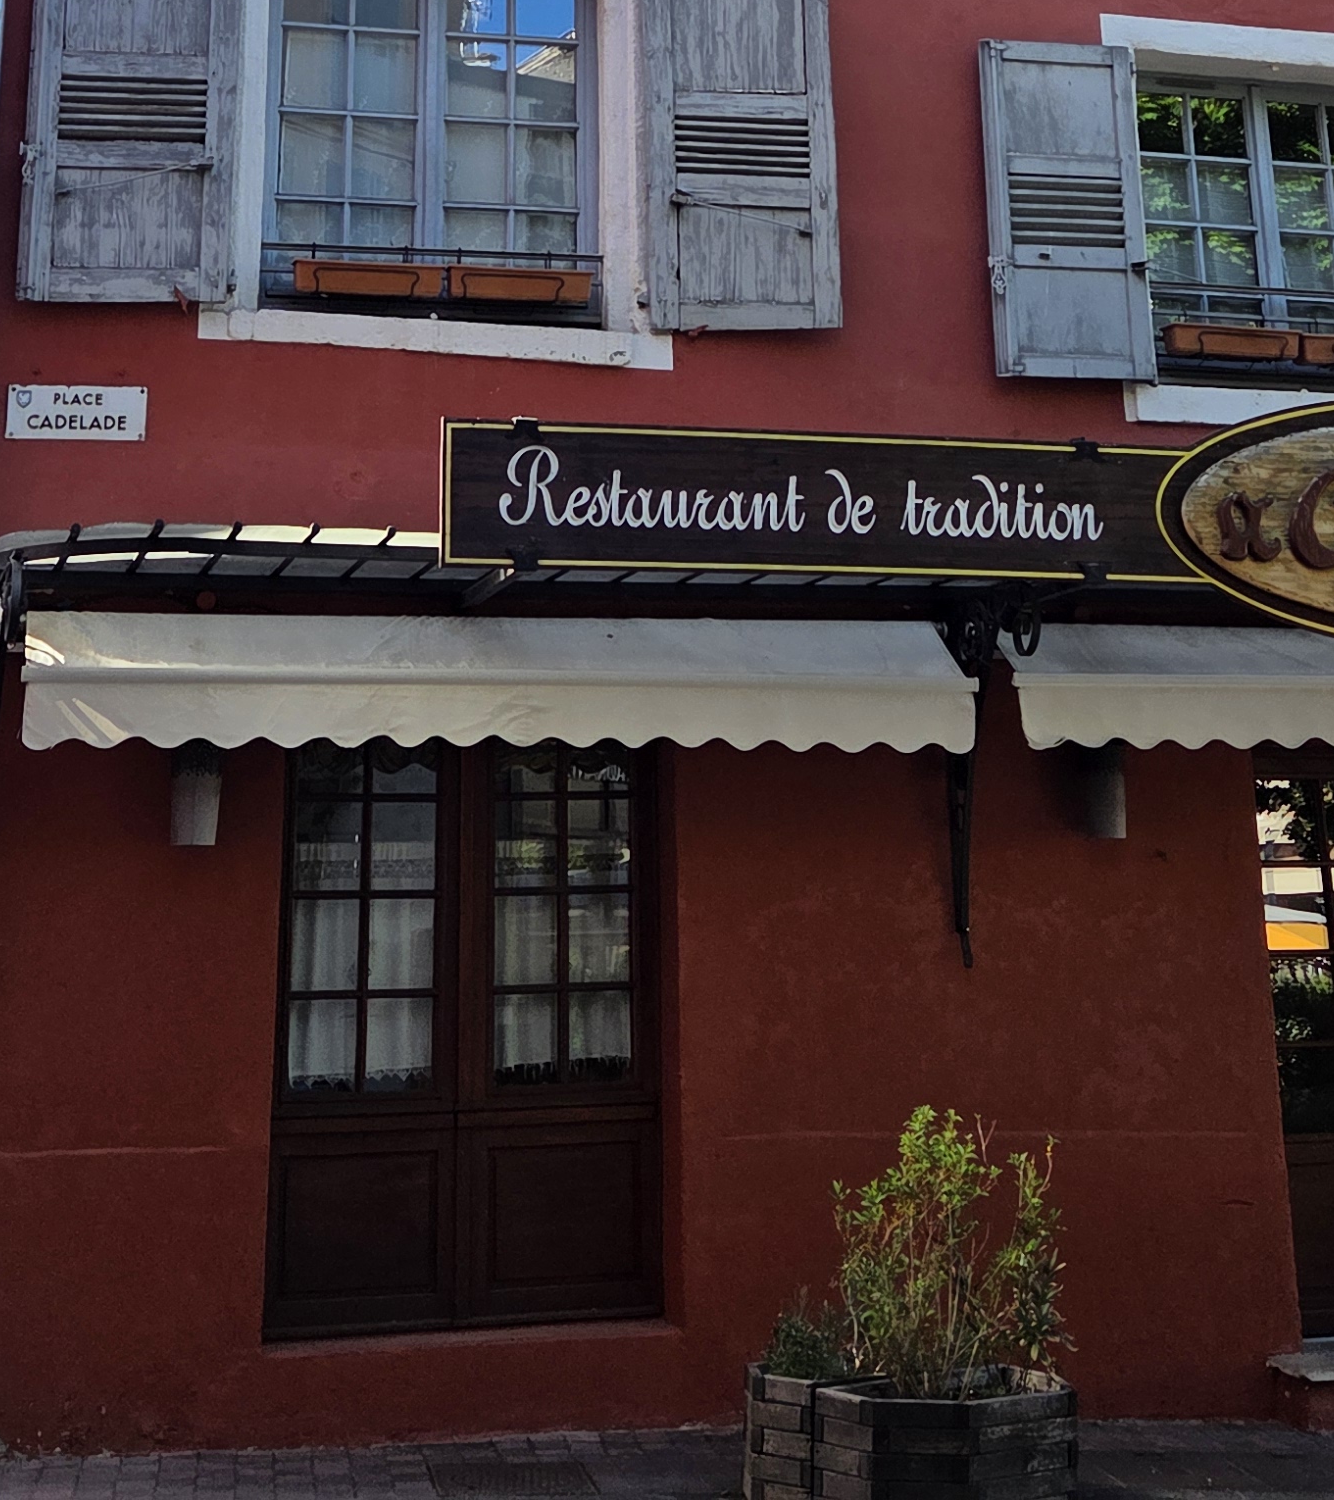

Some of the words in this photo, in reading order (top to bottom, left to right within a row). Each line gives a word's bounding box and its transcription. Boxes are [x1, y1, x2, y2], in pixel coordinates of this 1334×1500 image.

[53, 392, 103, 406] PLACE
[27, 414, 127, 431] CADELADE
[498, 444, 806, 532] Restaurant
[823, 468, 876, 536] de
[899, 473, 1103, 542] tradition
